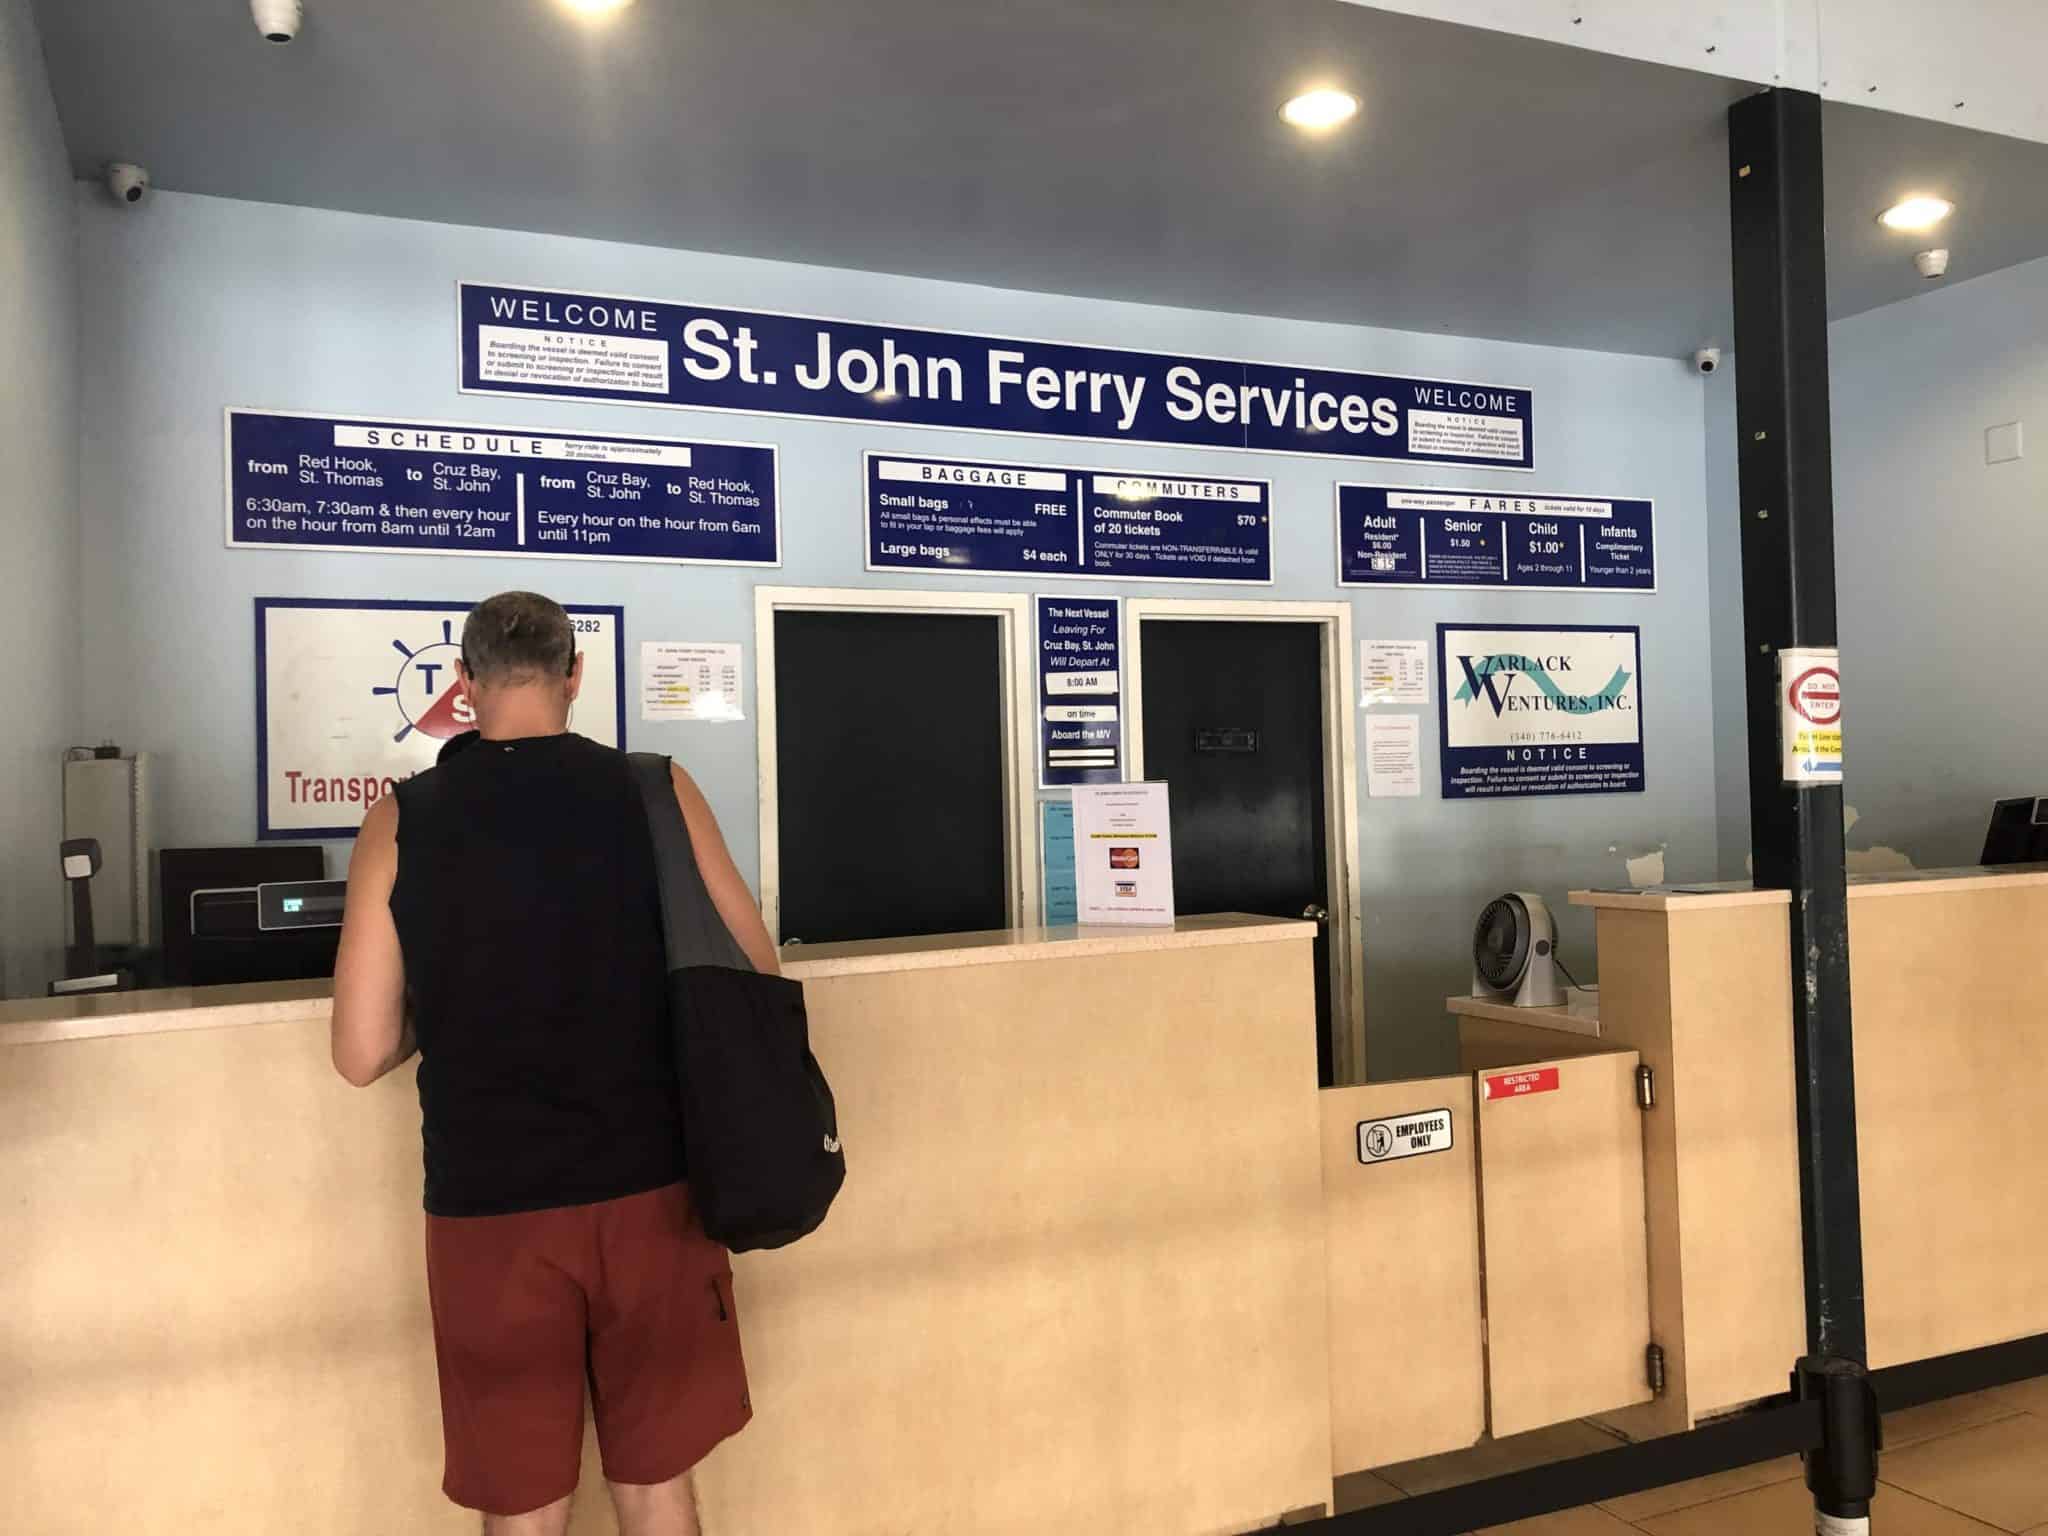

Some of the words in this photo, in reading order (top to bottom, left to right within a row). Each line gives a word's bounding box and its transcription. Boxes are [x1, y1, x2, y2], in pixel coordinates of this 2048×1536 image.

[490, 296, 658, 332] WELCOME
[544, 335, 607, 347] NOTICE
[683, 318, 777, 385] St.
[795, 332, 963, 401] John
[987, 348, 1146, 430] Ferry
[1165, 365, 1400, 437] Services
[1414, 386, 1517, 413] WELCOME
[1447, 416, 1486, 426] NOTICE
[367, 430, 543, 455] SCHEDULE
[247, 459, 288, 475] from
[299, 455, 329, 469] Red
[334, 457, 377, 473] Hook,
[406, 468, 423, 481] to
[432, 463, 466, 477] Cruz
[471, 465, 501, 481] Bay,
[922, 466, 1027, 486] BAGGAGE
[299, 471, 319, 484] St.
[325, 472, 384, 488] Thomas
[433, 478, 452, 491] St.
[456, 480, 490, 493] John
[540, 475, 576, 489] from
[586, 471, 618, 485] Cruz
[622, 473, 651, 489] Bay,
[688, 477, 715, 490] Red
[719, 479, 755, 494] Hook,
[586, 487, 604, 499] St.
[608, 487, 641, 500] John
[666, 482, 682, 495] to
[688, 491, 707, 504] St.
[710, 493, 760, 507] Thomas
[879, 494, 915, 507] Small
[918, 496, 949, 511] bags
[1470, 499, 1537, 513] FARES
[246, 498, 311, 516] 6:30am,
[316, 501, 375, 516] 7:30am
[379, 503, 391, 517] &
[395, 504, 427, 519] then
[432, 509, 473, 524] every
[478, 508, 511, 522] hour
[880, 511, 890, 519] All
[911, 513, 929, 522] bags
[1034, 503, 1068, 516] FREE
[1094, 507, 1151, 521] Commuter
[1154, 510, 1183, 522] Book
[246, 518, 267, 529] on
[272, 517, 297, 530] the
[302, 518, 338, 532] hour
[342, 519, 377, 533] from
[381, 521, 415, 535] 8am
[418, 522, 450, 536] until
[455, 524, 496, 538] 12am
[538, 511, 579, 528] Every
[583, 513, 614, 527] hour
[618, 516, 635, 528] on
[639, 516, 662, 529] the
[665, 517, 695, 531] hour
[698, 519, 728, 532] from
[732, 520, 760, 534] 6am
[1237, 514, 1256, 527] $70
[1363, 515, 1397, 529] Adult
[1444, 518, 1483, 533] Senior
[906, 523, 922, 532] your
[945, 524, 976, 535] baggage
[1005, 528, 1024, 537] apply
[1094, 522, 1106, 534] of
[1108, 523, 1122, 535] 20
[1124, 524, 1161, 537] tickets
[1528, 521, 1559, 536] Child
[1601, 525, 1638, 539] Infants
[538, 528, 568, 541] until
[573, 530, 610, 544] 11pm
[880, 542, 917, 557] Large
[919, 543, 950, 559] bags
[1529, 541, 1559, 554] $1.00
[1595, 542, 1644, 553] Complimentary
[1023, 549, 1037, 561] $4
[1039, 550, 1068, 563] each
[1610, 553, 1630, 562] Ticket
[1516, 563, 1534, 574] Ages
[1534, 563, 1540, 572] 2
[1540, 563, 1564, 574] through
[1566, 564, 1573, 573] 11
[1589, 566, 1614, 576] Younger
[1615, 566, 1629, 575] than
[1629, 566, 1634, 575] 2
[1635, 568, 1652, 576] years
[1048, 607, 1064, 618] The
[1065, 608, 1083, 618] Next
[1083, 608, 1110, 619] Vessel
[1053, 624, 1088, 637] Leaving
[1090, 624, 1106, 635] For
[1043, 640, 1063, 650] Cruz
[1064, 640, 1081, 653] Bay,
[1082, 640, 1093, 650] St.
[1095, 641, 1115, 651] John
[1050, 656, 1067, 667] Will
[1068, 656, 1098, 669] Depart
[1100, 657, 1110, 667] At
[415, 664, 442, 695] T
[1085, 677, 1098, 687] AM
[1456, 655, 1572, 702] VARLACK
[1479, 673, 1593, 719] VENTURES,
[1597, 695, 1632, 711] INC.
[451, 694, 477, 723] S
[1809, 701, 1834, 710] ENTER
[1079, 709, 1096, 719] time
[1051, 730, 1081, 740] Aboard
[1081, 730, 1095, 740] the
[1095, 729, 1111, 740] M/V
[1506, 747, 1587, 761] NOTICE
[285, 771, 416, 811] Transpo
[1503, 1072, 1541, 1086] RESTRICTED
[1514, 1083, 1531, 1093] AREA
[1396, 1118, 1445, 1137] EMPLOYEES
[1410, 1135, 1432, 1149] ONLY
